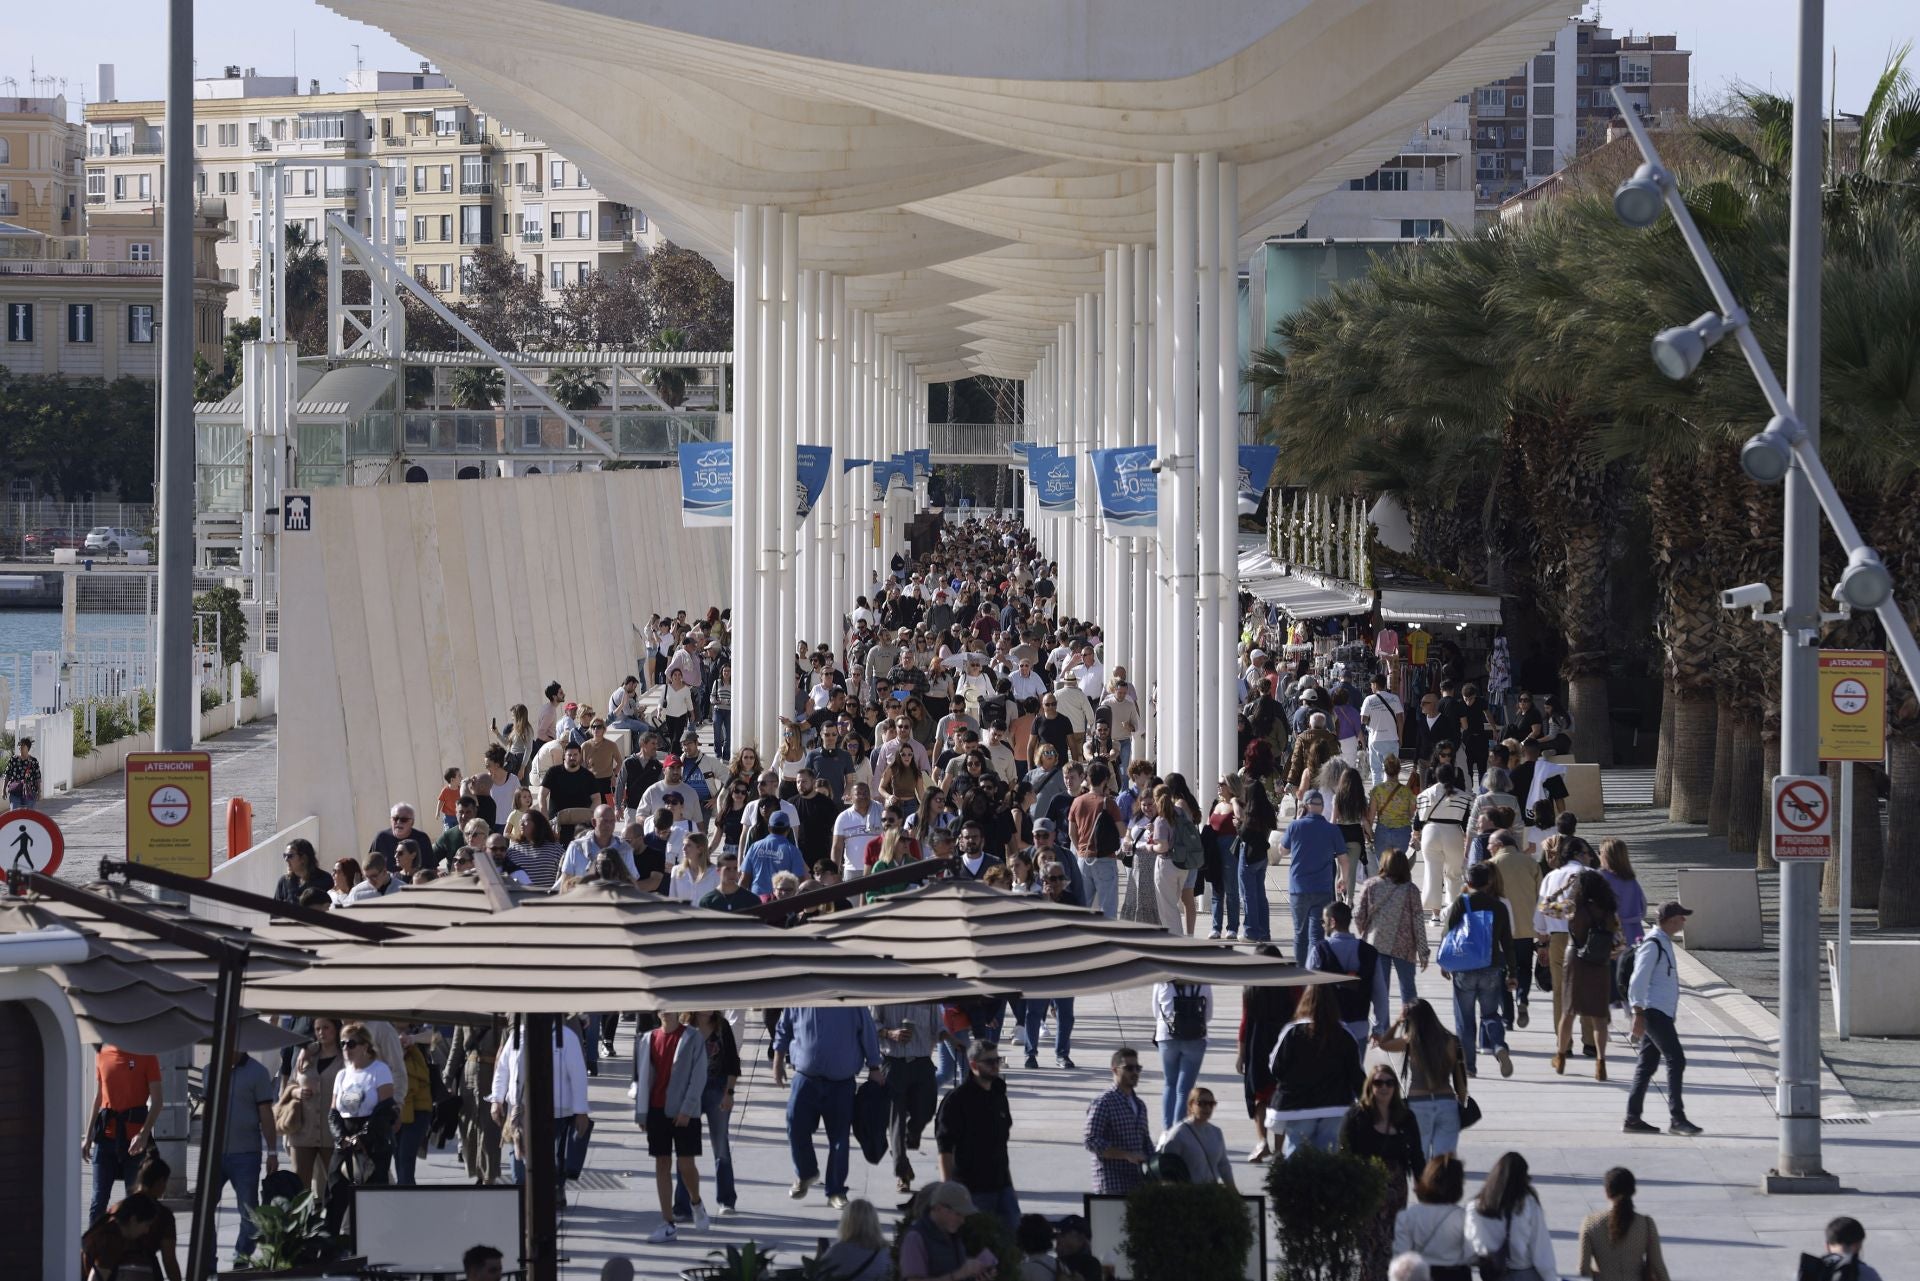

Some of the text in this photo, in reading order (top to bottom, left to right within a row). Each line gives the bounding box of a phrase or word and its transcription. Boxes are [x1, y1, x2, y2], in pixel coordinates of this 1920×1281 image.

[694, 471, 717, 488] 150
[144, 761, 194, 773] ¡ATENCIÓN!
[1781, 836, 1824, 845] PROHIBIDO
[1776, 846, 1830, 856] USAR DRONES
